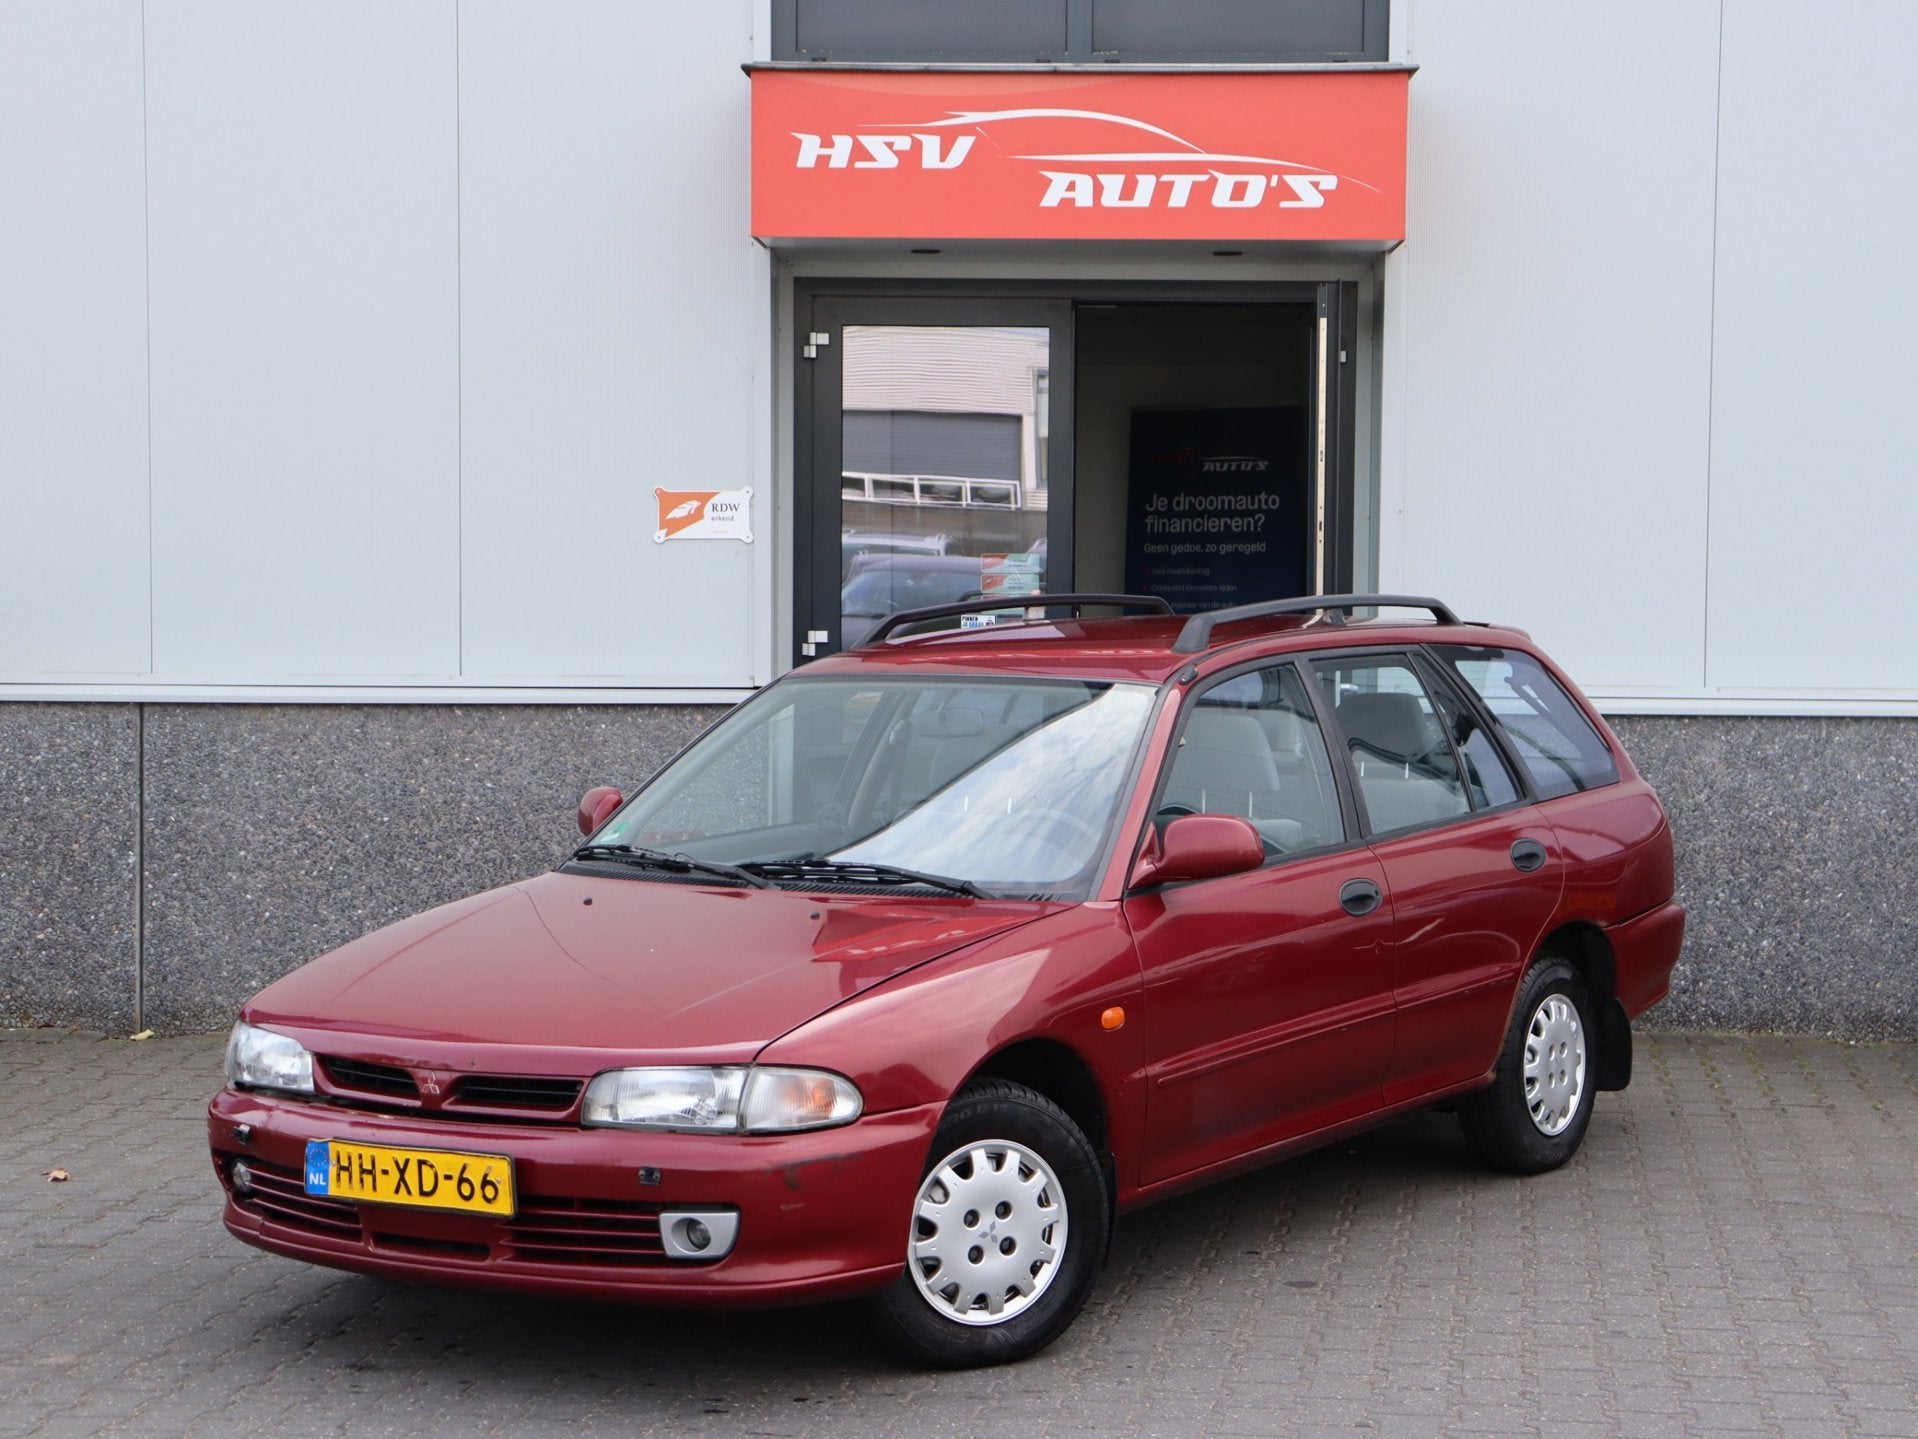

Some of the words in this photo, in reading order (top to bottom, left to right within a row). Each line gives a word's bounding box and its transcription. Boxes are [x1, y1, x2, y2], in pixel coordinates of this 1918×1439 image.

[790, 131, 977, 169] HSV
[1038, 168, 1339, 208] AUTO'S
[1202, 460, 1269, 472] AUTO'S
[711, 503, 740, 513] RDW
[1145, 493, 1169, 511] Je
[1172, 491, 1280, 511] droomauto
[711, 514, 735, 522] erkend
[1144, 513, 1266, 533] financieren?
[1144, 543, 1169, 553] Geen
[1205, 543, 1217, 552] zo
[1219, 541, 1267, 555] geregeld
[309, 1172, 326, 1186] NL
[335, 1150, 500, 1204] HH-XD-66
